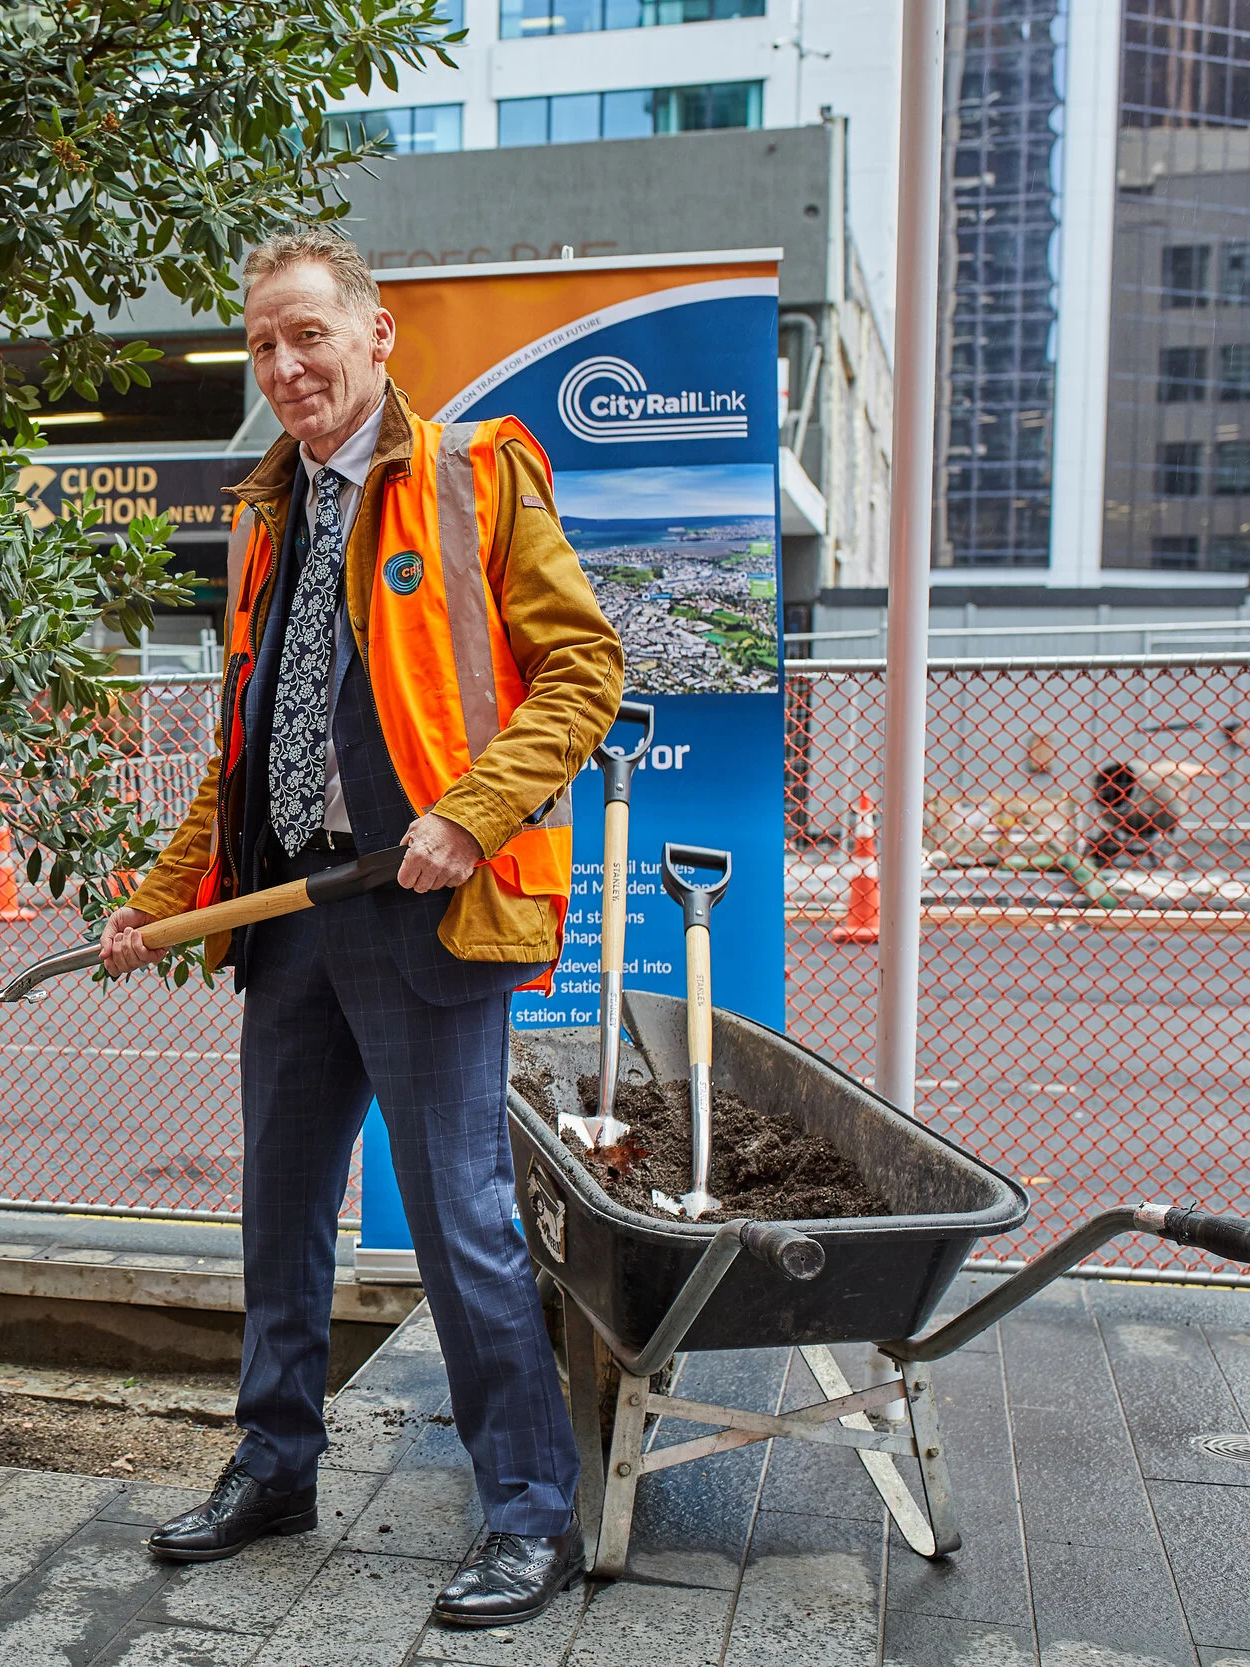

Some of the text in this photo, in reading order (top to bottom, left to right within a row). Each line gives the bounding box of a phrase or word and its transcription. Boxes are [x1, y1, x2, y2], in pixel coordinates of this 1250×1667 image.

[438, 317, 601, 423] LAND ON TRACK FOR A BETTER FUTURE
[61, 466, 158, 494] CLOUD
[169, 505, 216, 523] NEW
[221, 504, 237, 523] Z
[635, 737, 690, 771] for
[570, 880, 588, 895] nd
[592, 880, 604, 895] M
[625, 880, 656, 895] den
[612, 862, 622, 902] STANLEY
[565, 908, 583, 924] nd
[555, 958, 673, 974] edeveled into
[560, 979, 601, 993] statio
[516, 1007, 566, 1022] station
[571, 1007, 592, 1022] for
